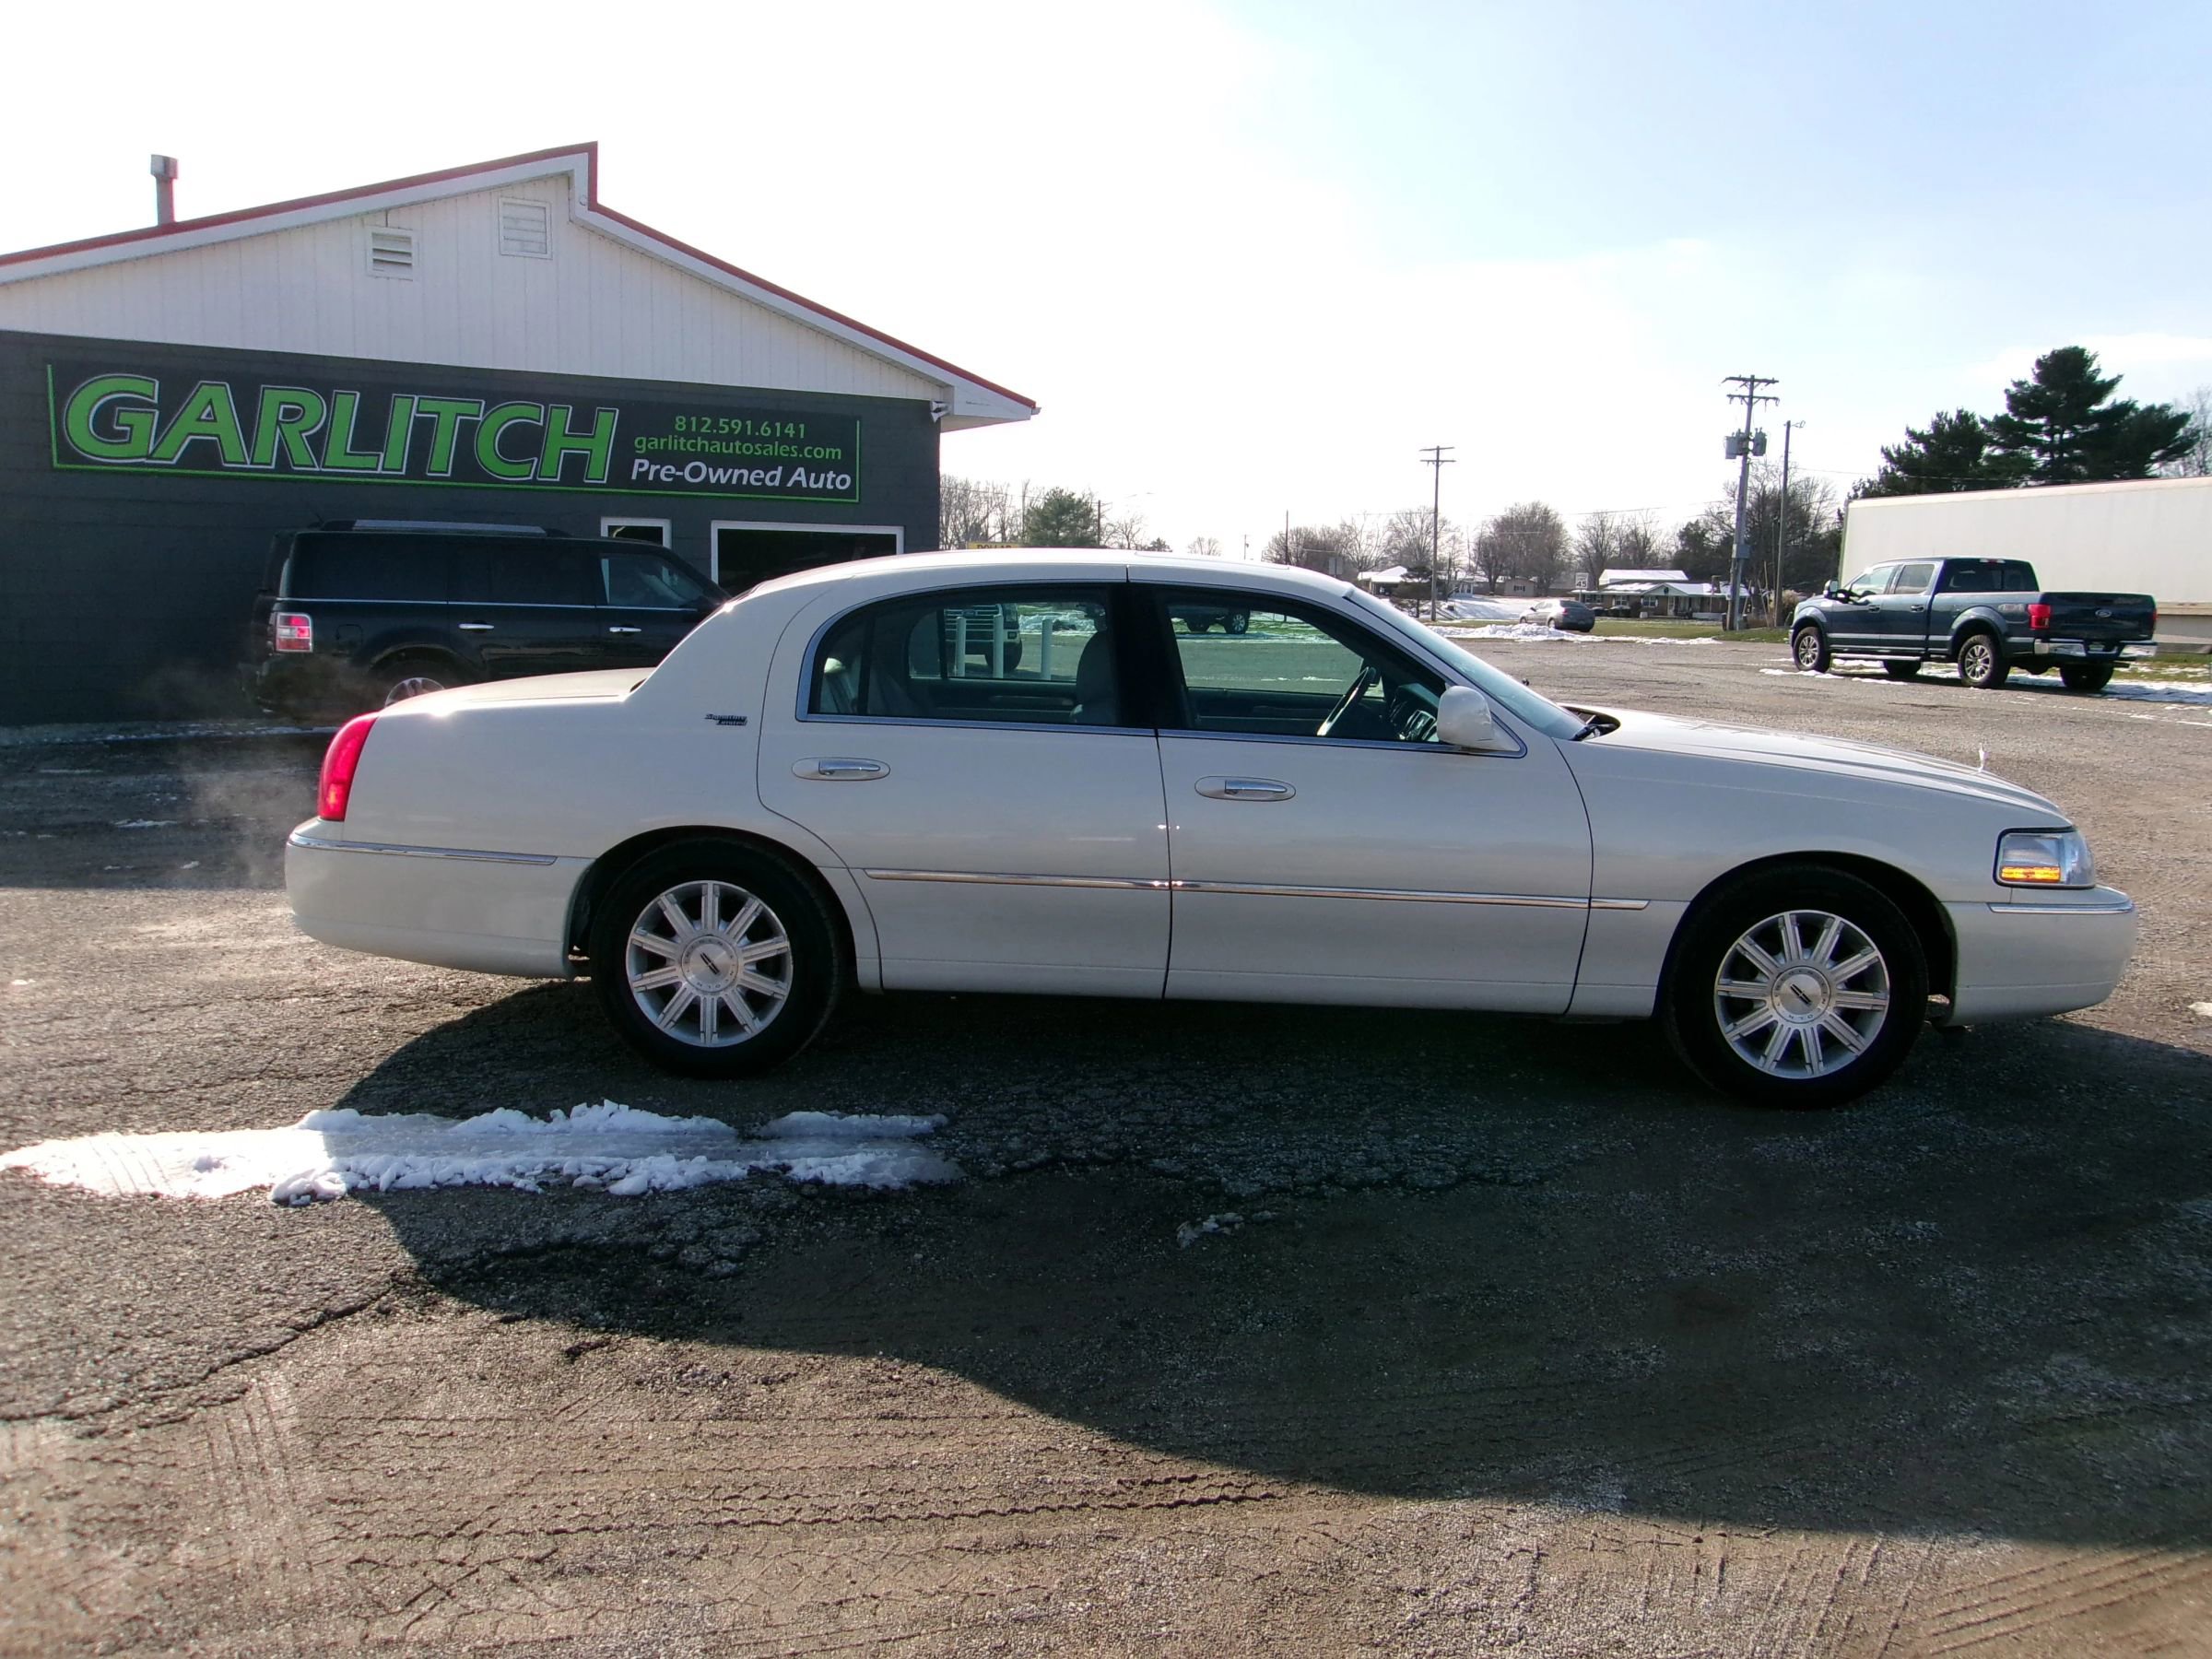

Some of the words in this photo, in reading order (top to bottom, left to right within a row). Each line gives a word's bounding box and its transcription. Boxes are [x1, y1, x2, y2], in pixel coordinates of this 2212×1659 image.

[64, 373, 618, 483] GARLITCH
[675, 416, 806, 439] 812.591.6141
[634, 435, 841, 460] garlitchautosales.com
[630, 458, 782, 487] Pre-Owned
[786, 466, 852, 489] Auto
